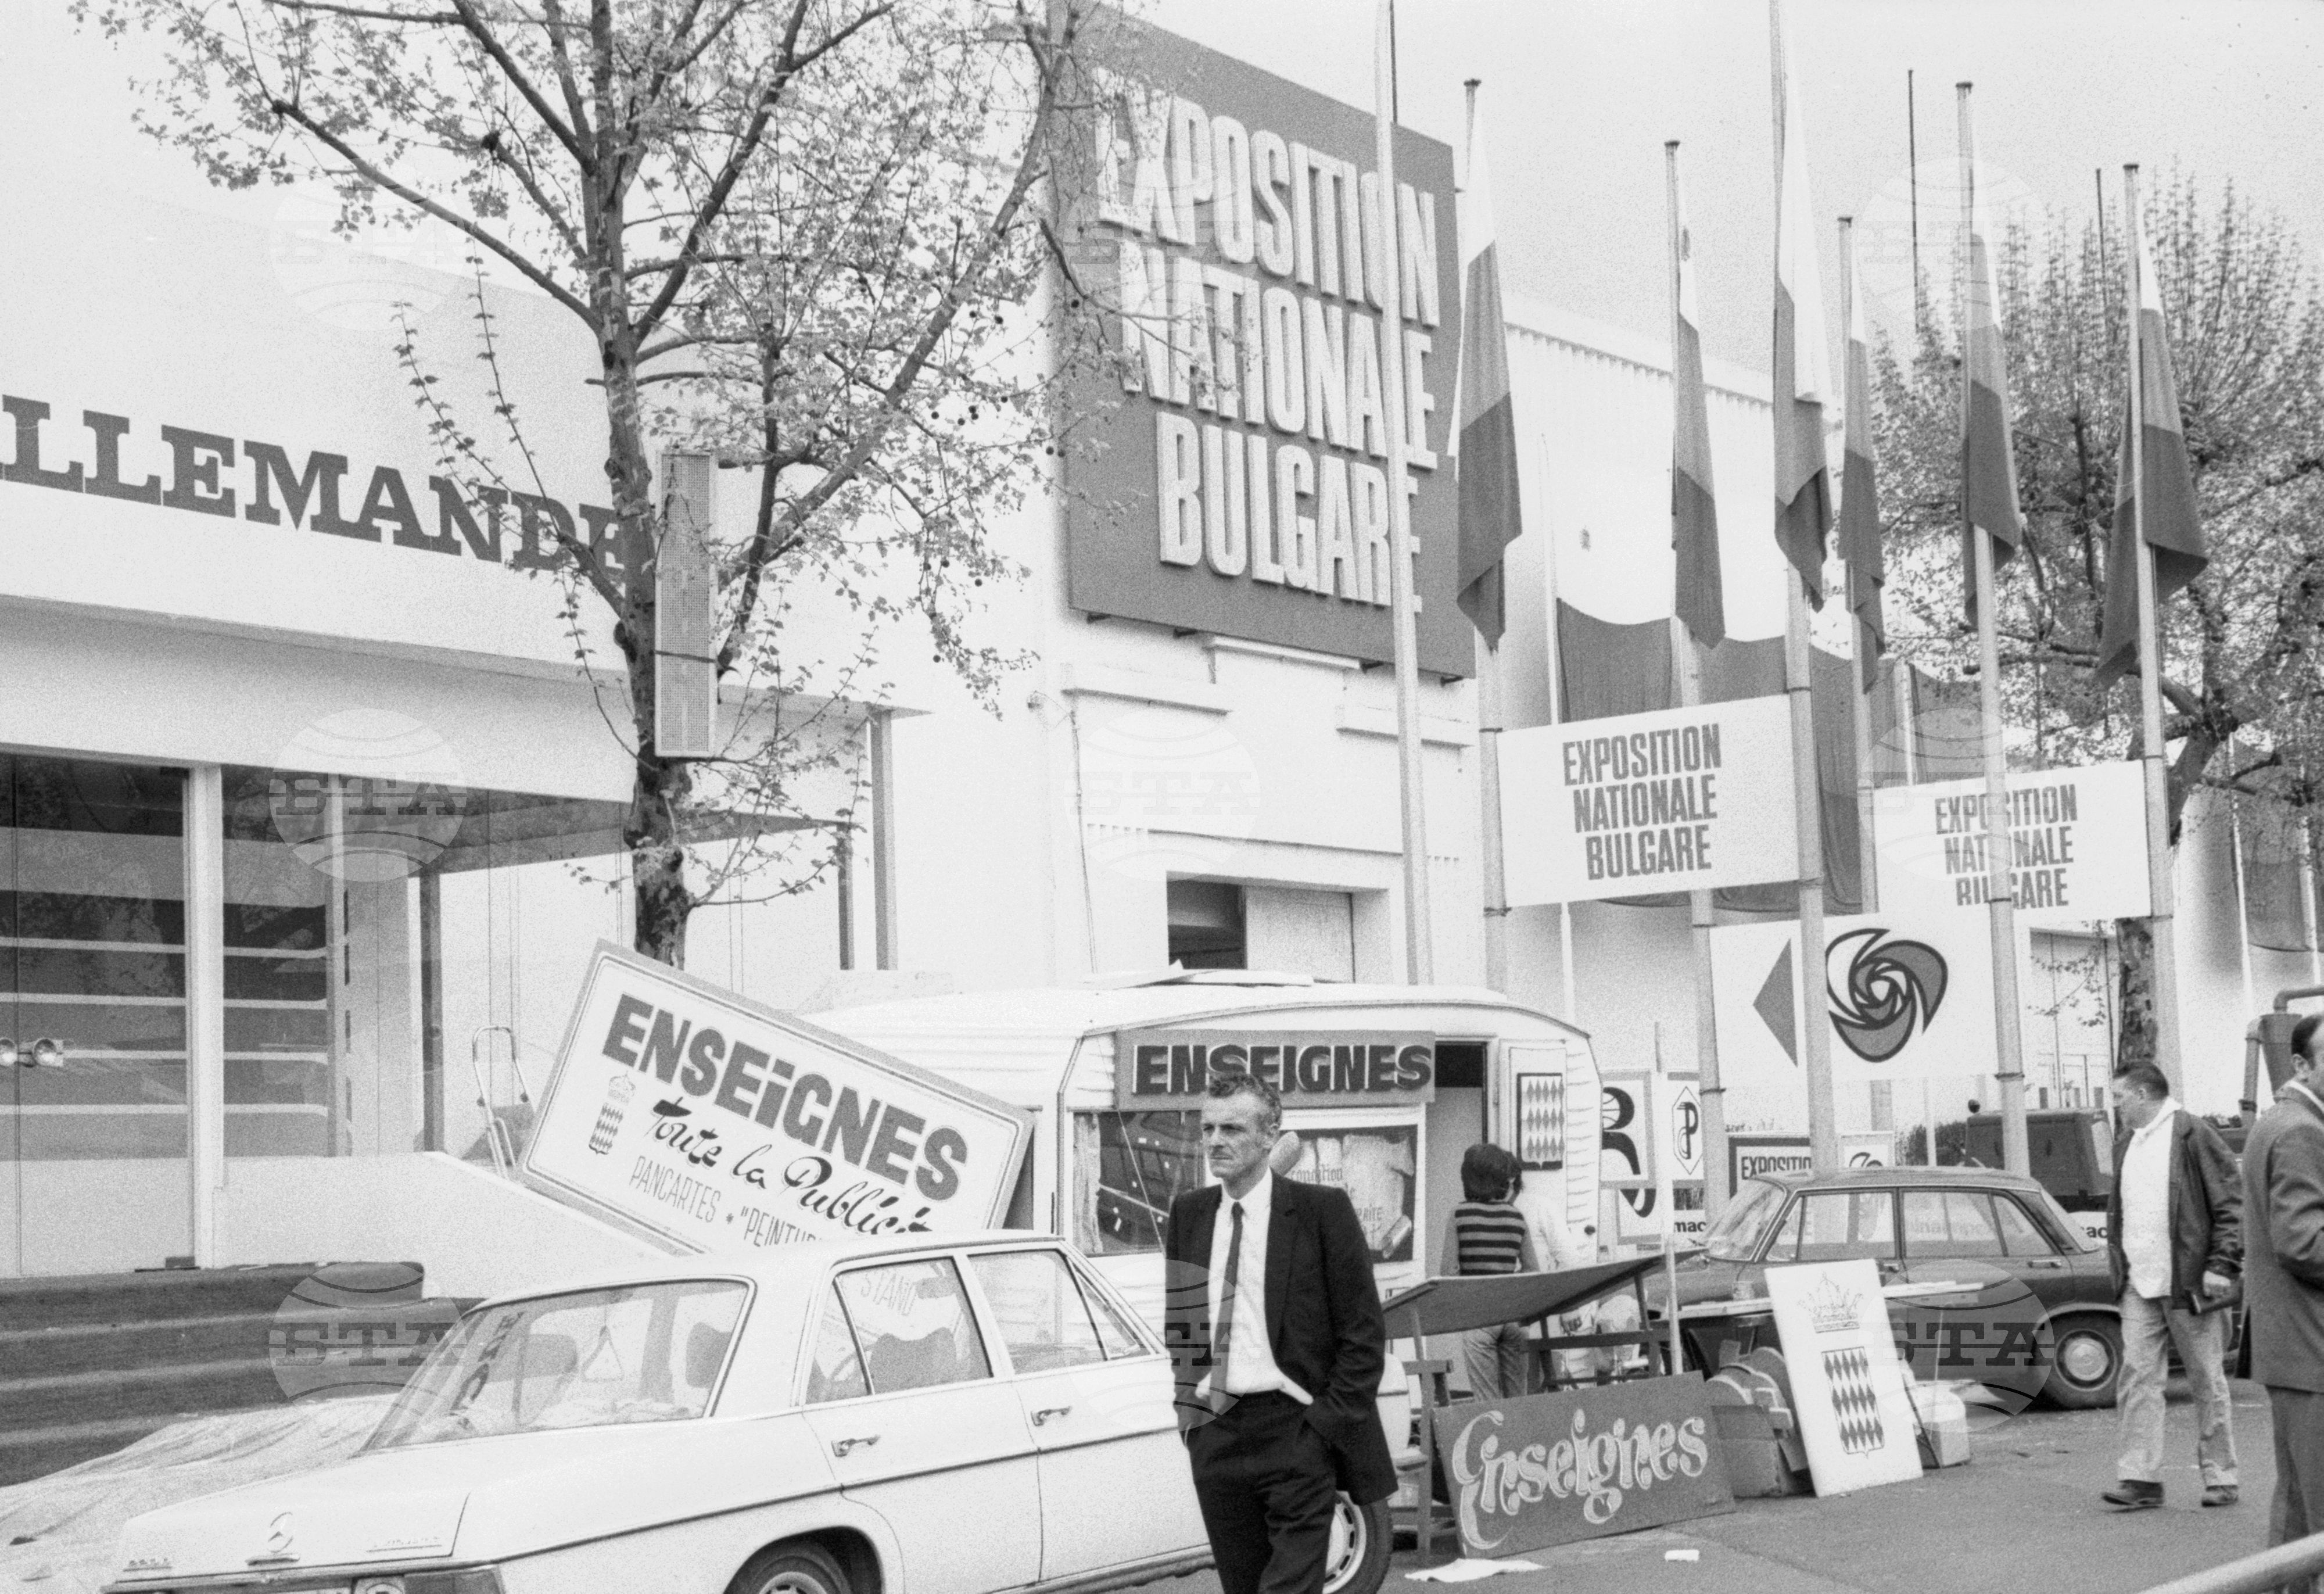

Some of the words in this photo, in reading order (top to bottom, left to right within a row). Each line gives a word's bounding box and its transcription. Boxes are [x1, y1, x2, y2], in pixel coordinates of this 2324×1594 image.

[1119, 239, 1438, 469] NATIONAE
[0, 394, 625, 575] LLEMANDE
[1156, 411, 1422, 612] BULGAR
[1562, 723, 1722, 786] EXPOSITION
[1573, 774, 1717, 833] NATIONALE
[1585, 825, 1712, 880] BULGARE
[1945, 825, 2074, 875] NATNALE
[1956, 868, 2069, 909] BUGARE
[1132, 1044, 1432, 1095] ENSEIGNES
[644, 1096, 722, 1167] Toute
[732, 1144, 773, 1190] la
[1741, 1156, 1812, 1180] EXPOSITIO
[629, 1155, 722, 1223] PANCARTES
[2080, 1226, 2108, 1239] ac
[1452, 1409, 1708, 1549] Enseignes
